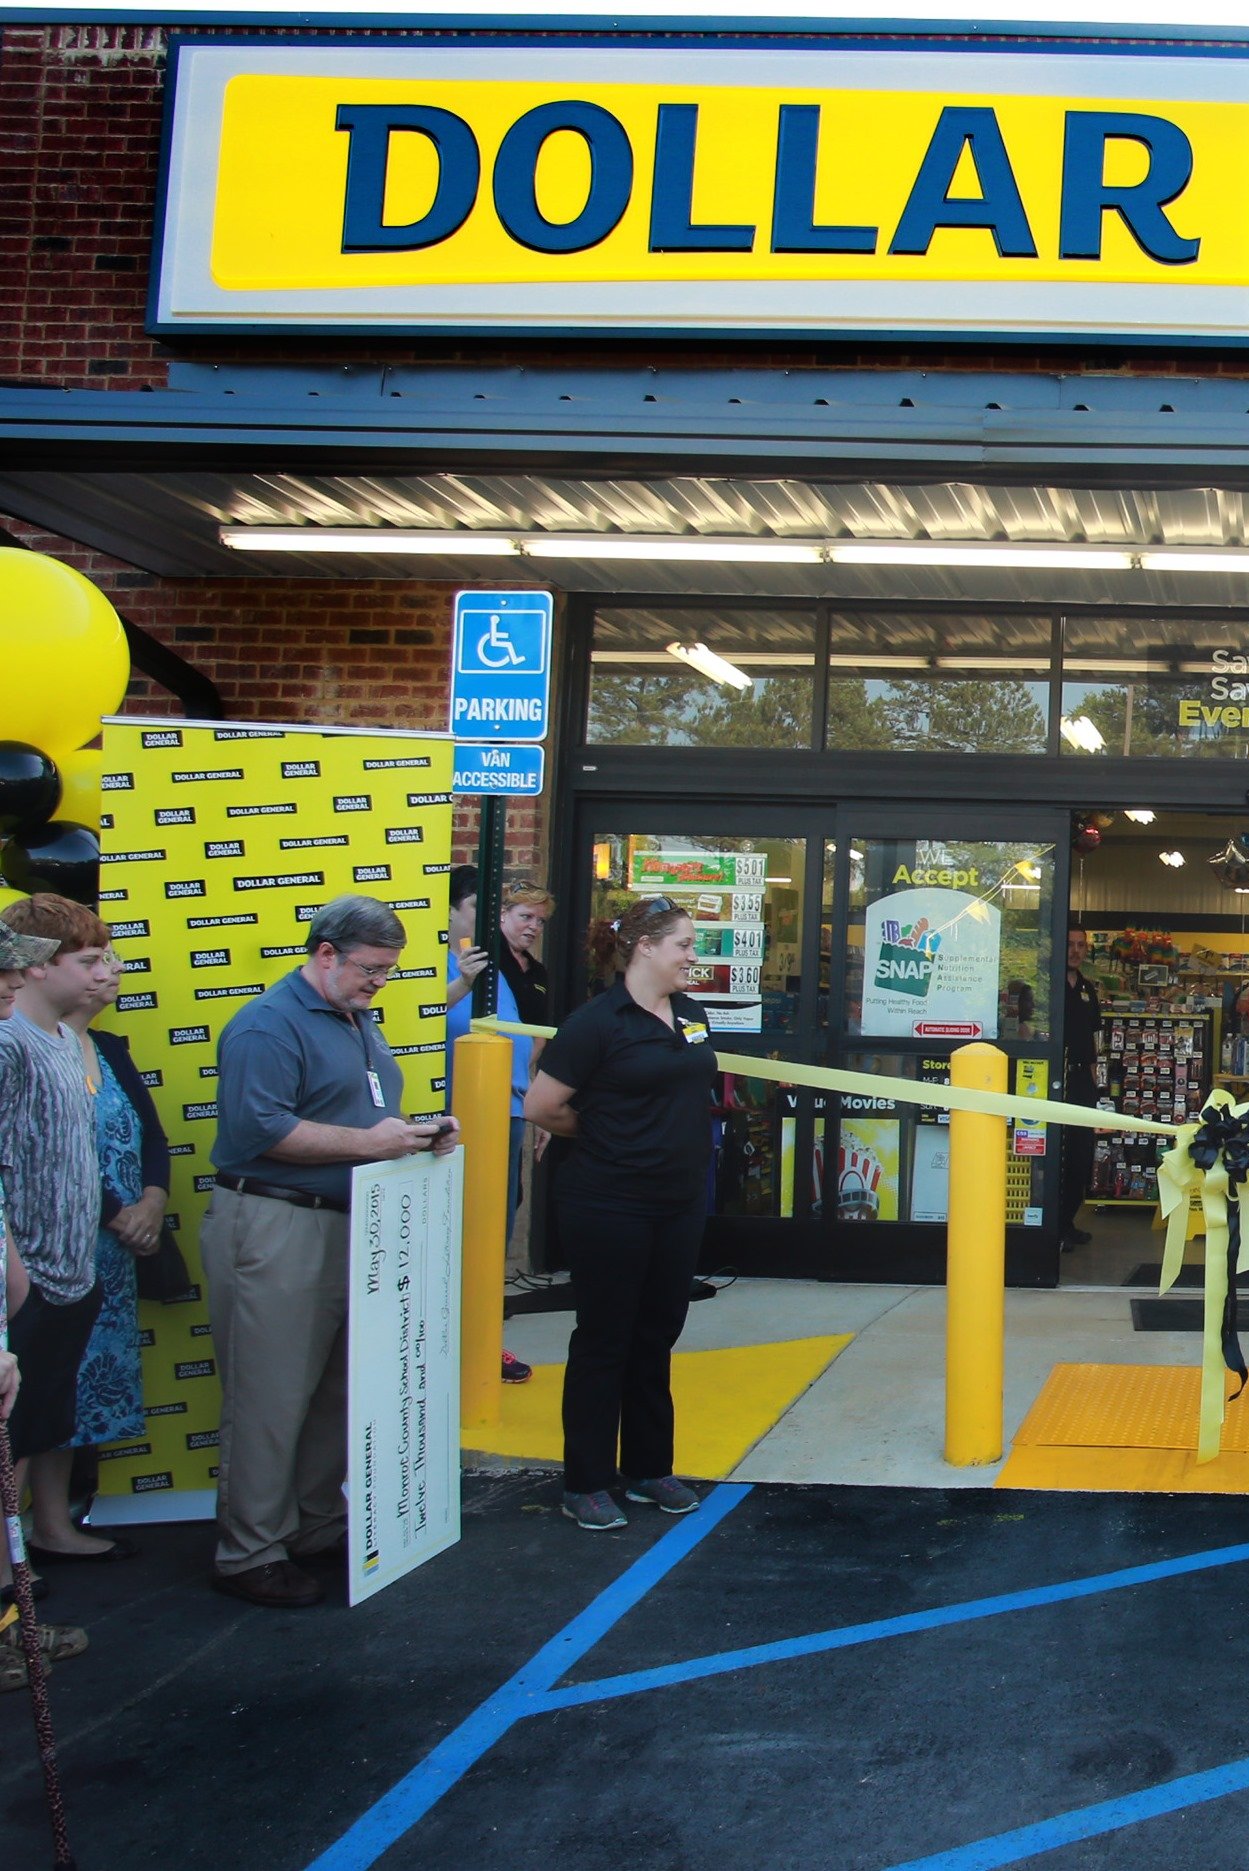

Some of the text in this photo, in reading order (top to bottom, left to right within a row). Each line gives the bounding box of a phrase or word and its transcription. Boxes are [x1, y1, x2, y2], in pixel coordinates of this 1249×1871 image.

[335, 99, 1201, 266] DOLLAR
[455, 698, 542, 722] PARKING
[481, 752, 510, 767] VAN
[207, 771, 241, 779] GENERAL
[453, 771, 537, 789] ACCESSIBLE
[410, 795, 447, 803] DOLLAR
[261, 805, 294, 814] GENERAL
[158, 816, 193, 824] GENERAL
[128, 852, 164, 860] GENERAL
[921, 849, 953, 865] WE
[237, 874, 321, 888] DOLLAR GENERAL
[738, 877, 762, 885] PLUS TAX
[892, 864, 979, 889] Accept
[170, 882, 200, 890] DOLLAR
[395, 901, 428, 909] GENERAL
[190, 918, 220, 926] DOLLAR
[195, 951, 225, 959] DOLLAR
[264, 948, 294, 956] DOLLAR
[194, 958, 228, 966] GENERAL
[876, 960, 932, 979] SNAP
[937, 964, 975, 972] Nutrition
[937, 974, 983, 982] Assistance
[229, 987, 262, 995] GENERAL
[936, 984, 972, 993] Program
[121, 995, 151, 1003] DOLLAR
[119, 1001, 155, 1009] GENERAL
[174, 1028, 204, 1036] DOLLAR
[841, 1096, 896, 1110] Movies
[367, 1250, 387, 1295] May
[397, 1396, 412, 1455] County
[414, 1398, 427, 1477] Thousand
[365, 1421, 373, 1489] GENERAL
[138, 1475, 167, 1484] DOLLAR
[136, 1481, 169, 1491] GENERAL
[414, 1480, 427, 1540] Twelve
